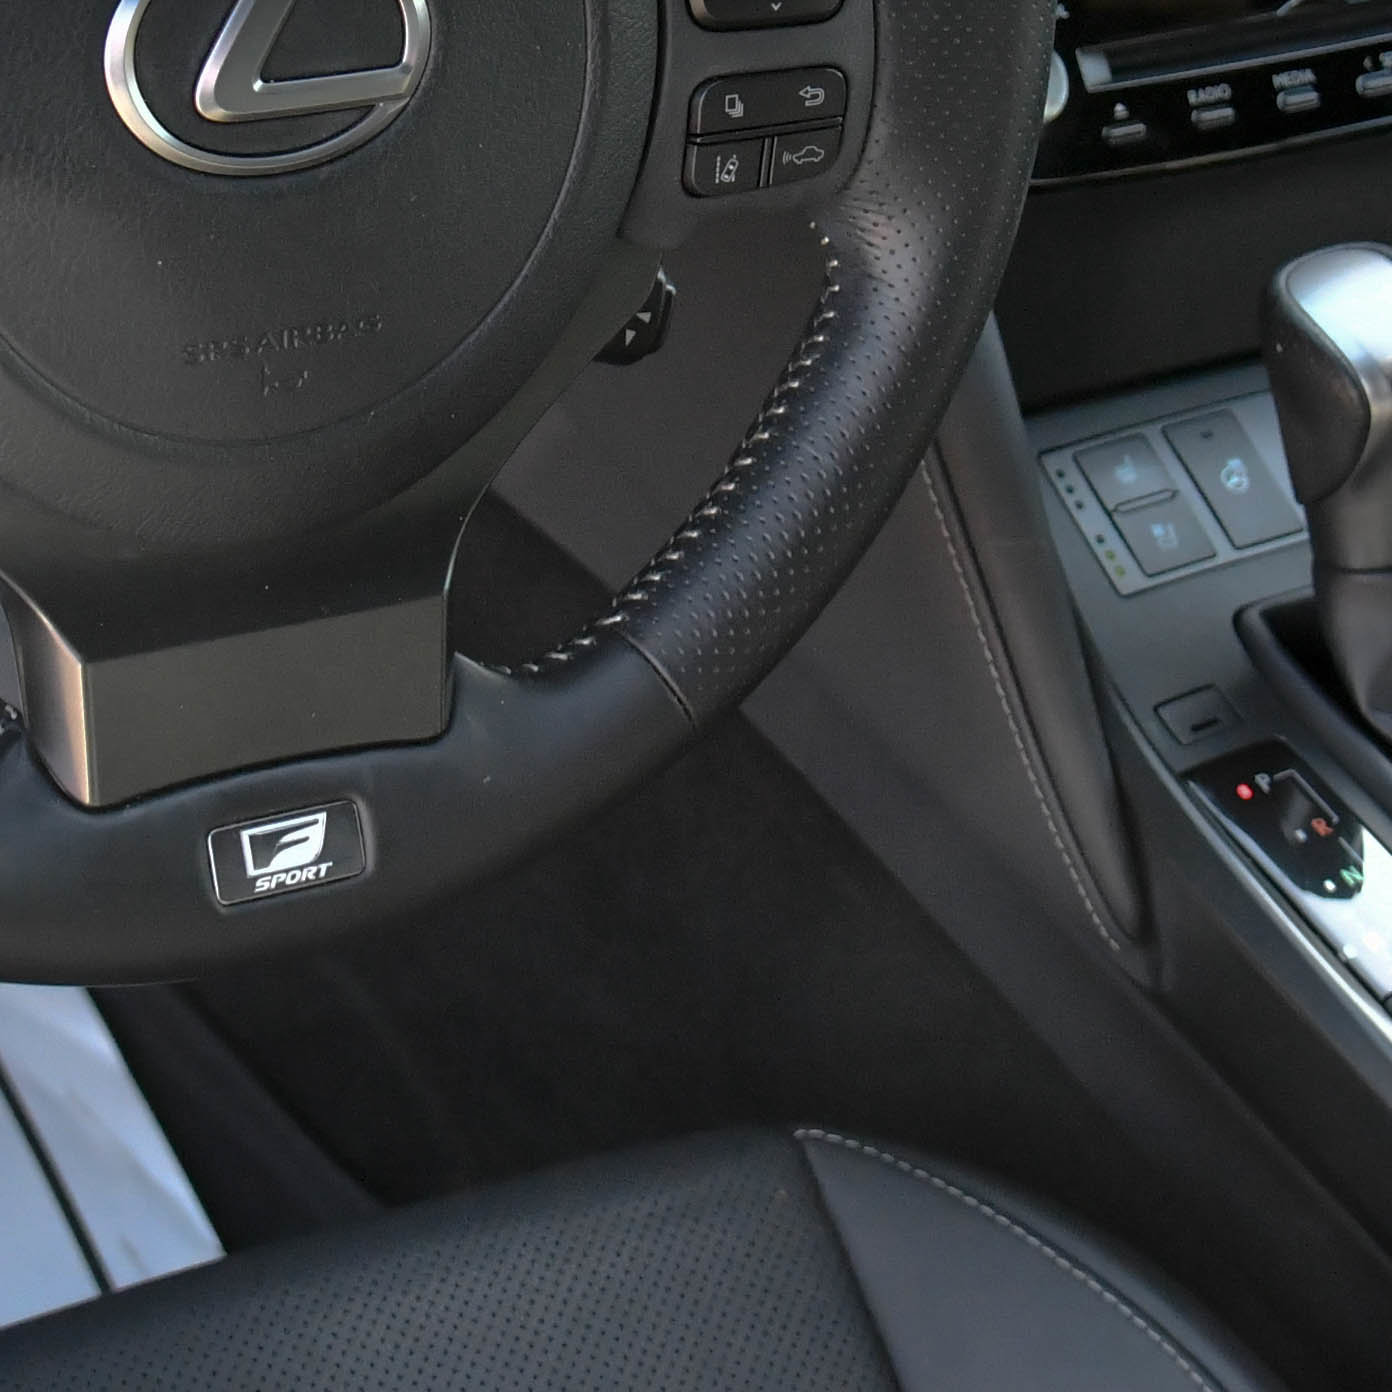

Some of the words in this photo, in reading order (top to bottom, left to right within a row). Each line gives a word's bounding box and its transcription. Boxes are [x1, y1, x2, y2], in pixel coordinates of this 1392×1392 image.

[1187, 83, 1232, 107] RADIO
[1254, 772, 1271, 795] P
[1311, 816, 1335, 838] R
[254, 862, 334, 894] SPORT
[1340, 864, 1365, 887] N
